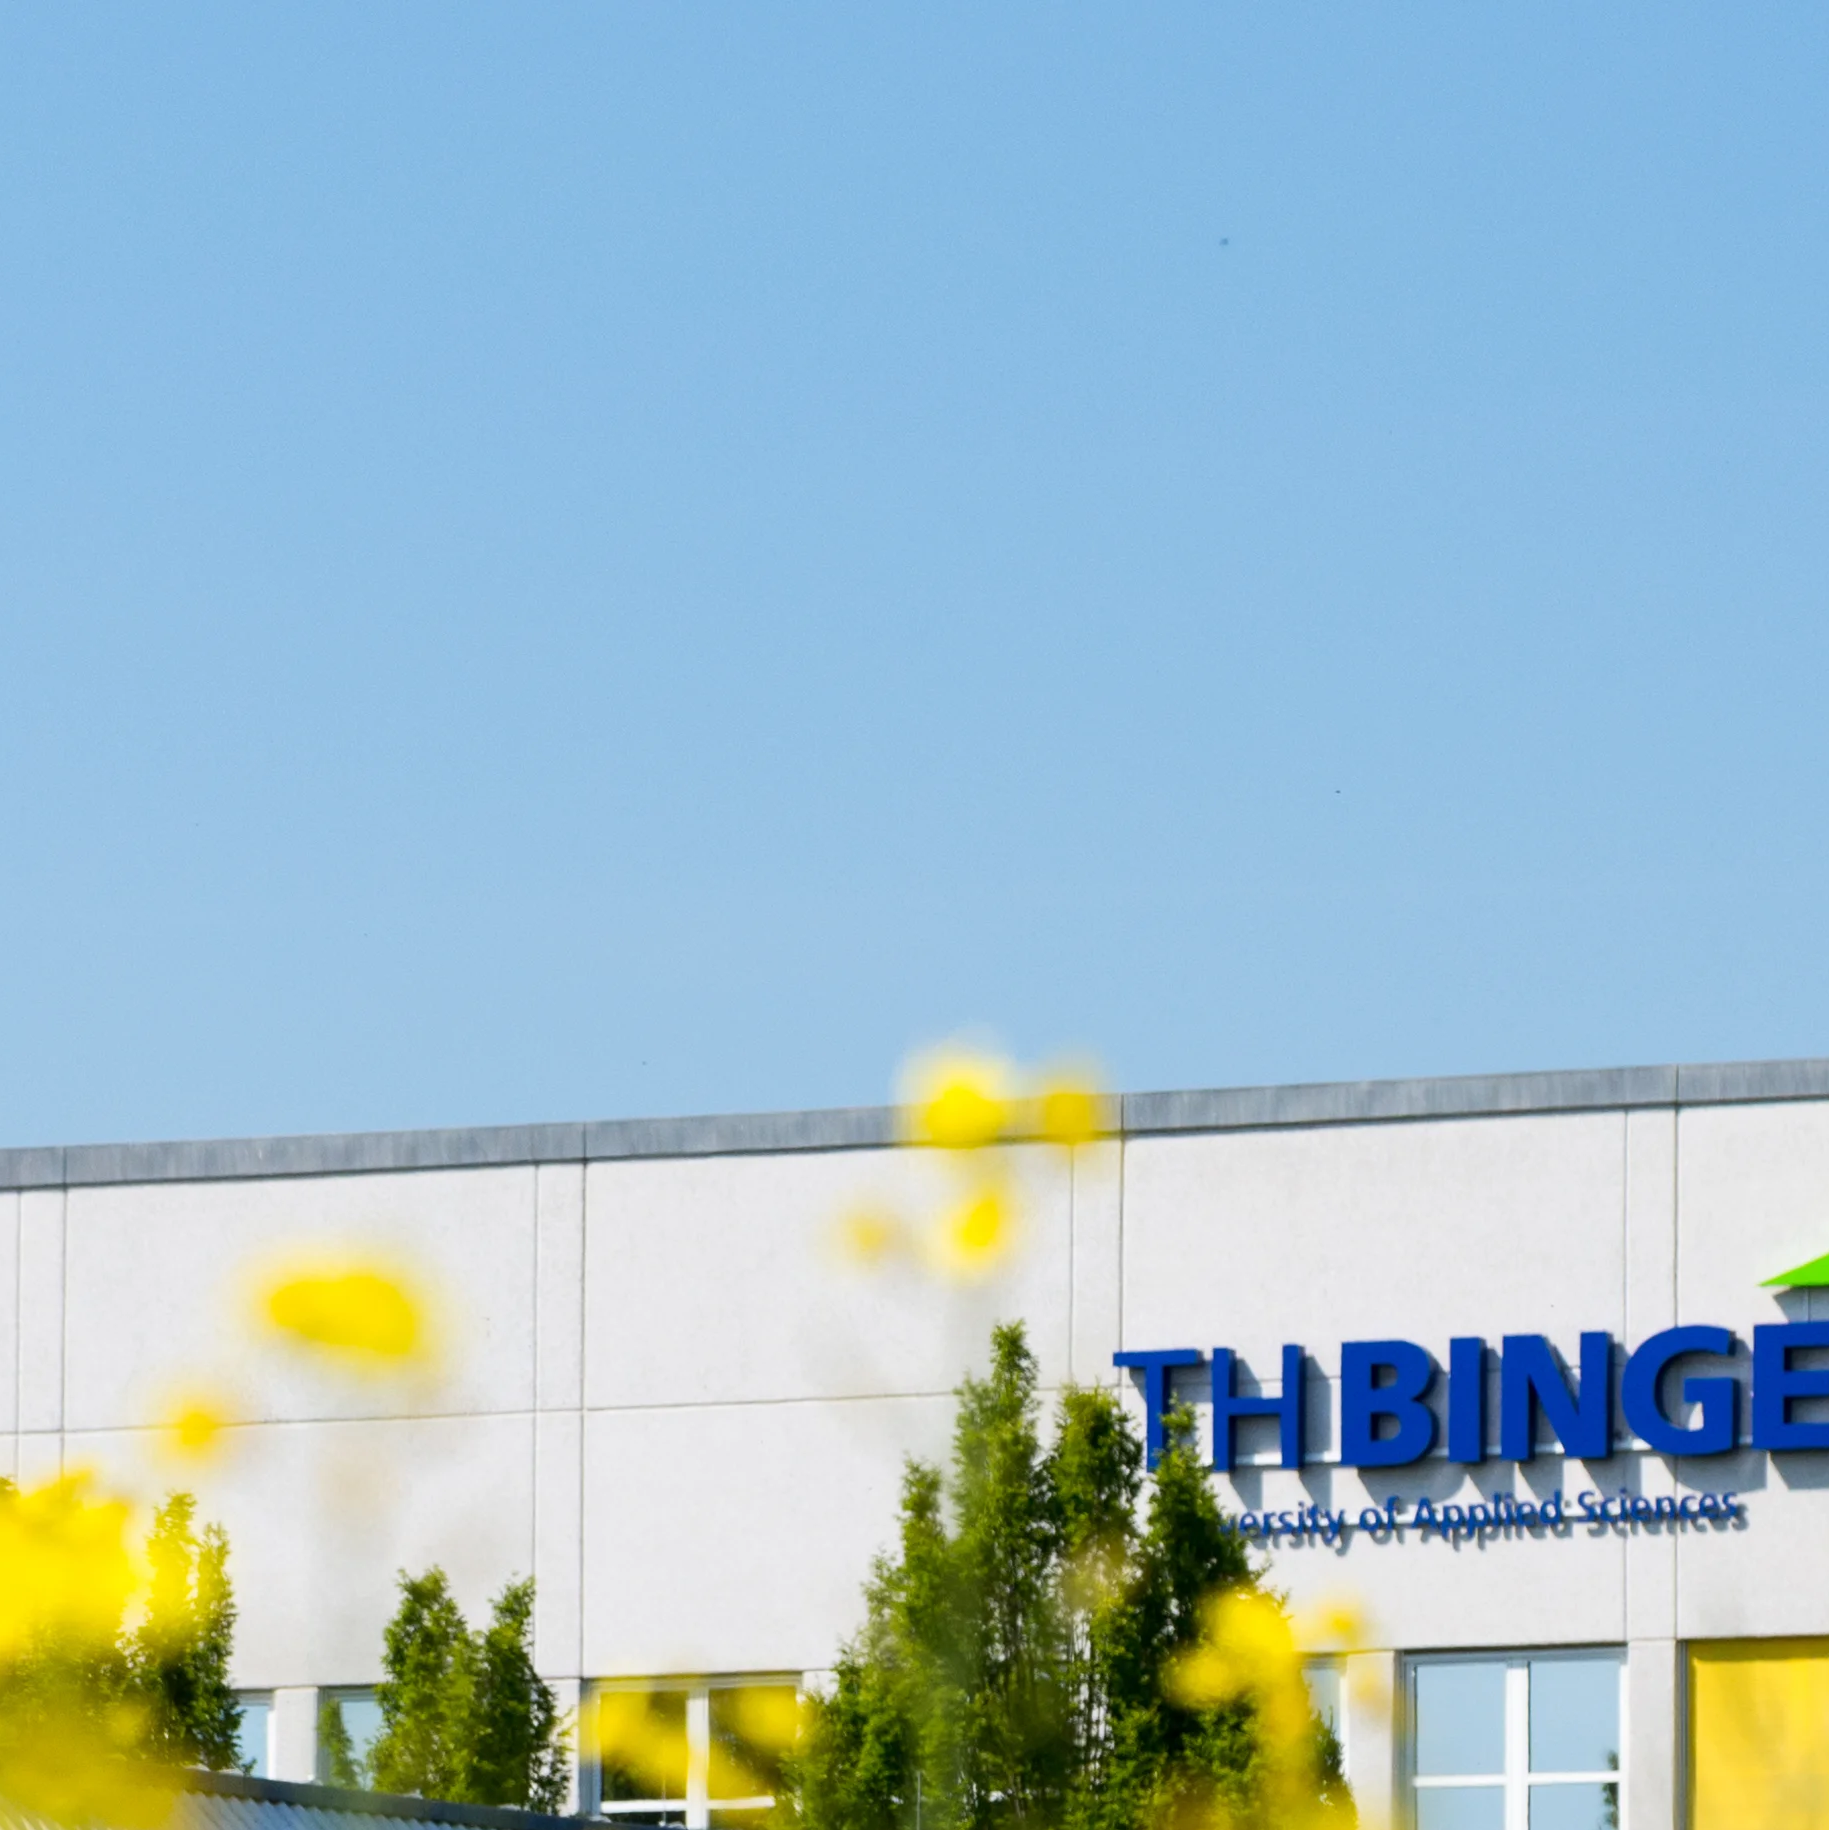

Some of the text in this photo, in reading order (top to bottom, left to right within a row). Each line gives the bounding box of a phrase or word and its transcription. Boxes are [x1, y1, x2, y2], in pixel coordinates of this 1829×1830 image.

[1112, 1343, 1304, 1474] TH
[1358, 1495, 1401, 1533] of
[1410, 1488, 1563, 1542] Applied
[1576, 1487, 1739, 1525] Sciences
